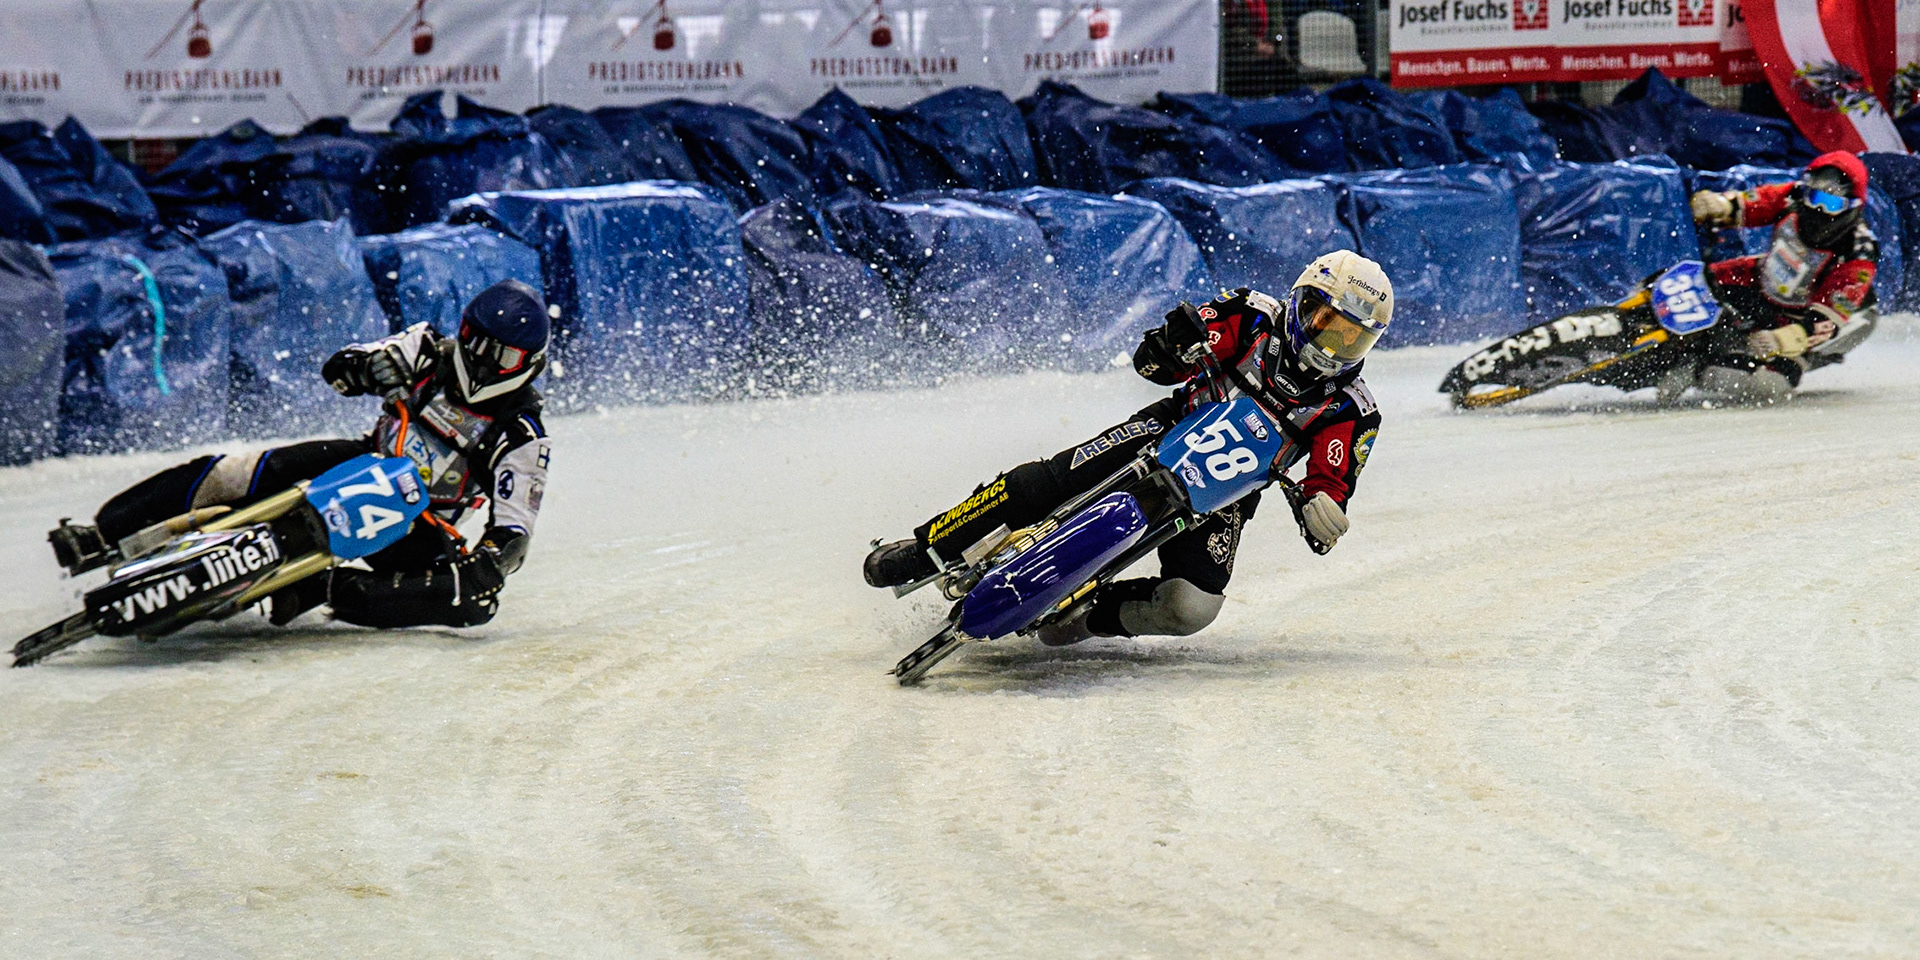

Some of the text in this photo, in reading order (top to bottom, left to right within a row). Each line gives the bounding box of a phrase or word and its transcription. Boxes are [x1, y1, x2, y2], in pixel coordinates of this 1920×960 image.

[1399, 0, 1508, 29] Josef Fuchs
[1564, 0, 1673, 23] Josef Fuchs
[1398, 55, 1550, 76] Menschen. Bauen. Werte.
[1561, 54, 1628, 71] Menschen.
[1674, 51, 1714, 67] Werte.
[1660, 274, 1710, 323] 357
[1184, 419, 1259, 481] 58
[337, 465, 405, 540] 74
